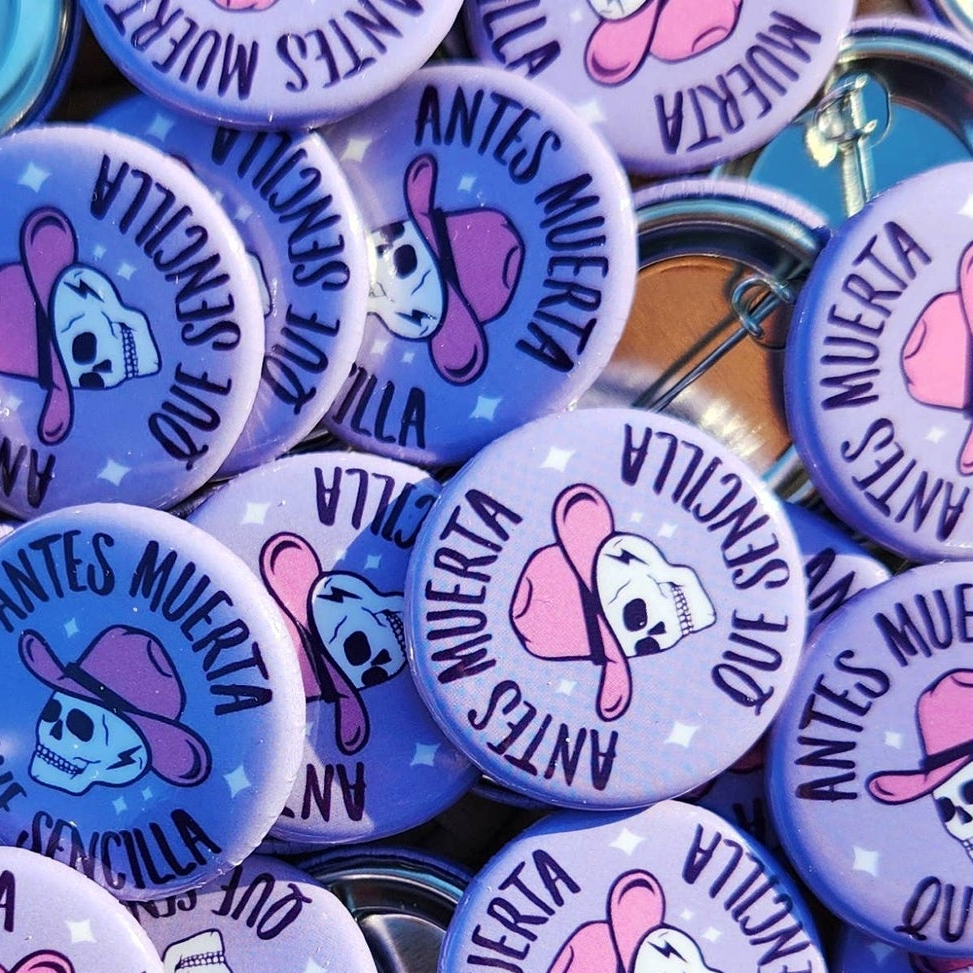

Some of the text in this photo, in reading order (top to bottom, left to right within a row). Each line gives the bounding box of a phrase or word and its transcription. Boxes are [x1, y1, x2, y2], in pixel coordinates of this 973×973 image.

[104, 0, 259, 100] MUERT
[276, 0, 424, 93] NTES
[655, 12, 821, 153] MUERTA
[414, 86, 560, 184] ANTES
[516, 173, 609, 372] MUERTA
[90, 155, 241, 469] QUE SENCILLA
[263, 303, 340, 414] QUE
[820, 222, 932, 411] MUERTA
[331, 363, 425, 449] ILLA
[314, 466, 437, 549] CILLA
[841, 418, 971, 542] ANTES
[130, 541, 272, 715] MUERTA
[621, 423, 789, 715] QUE SENCILLA
[426, 489, 618, 791] ANTES MUERTA
[795, 650, 890, 802] ANTES
[874, 583, 973, 667] MUE
[16, 809, 222, 889] SENCILLA
[211, 866, 313, 941] QUE
[894, 875, 973, 943] QU
